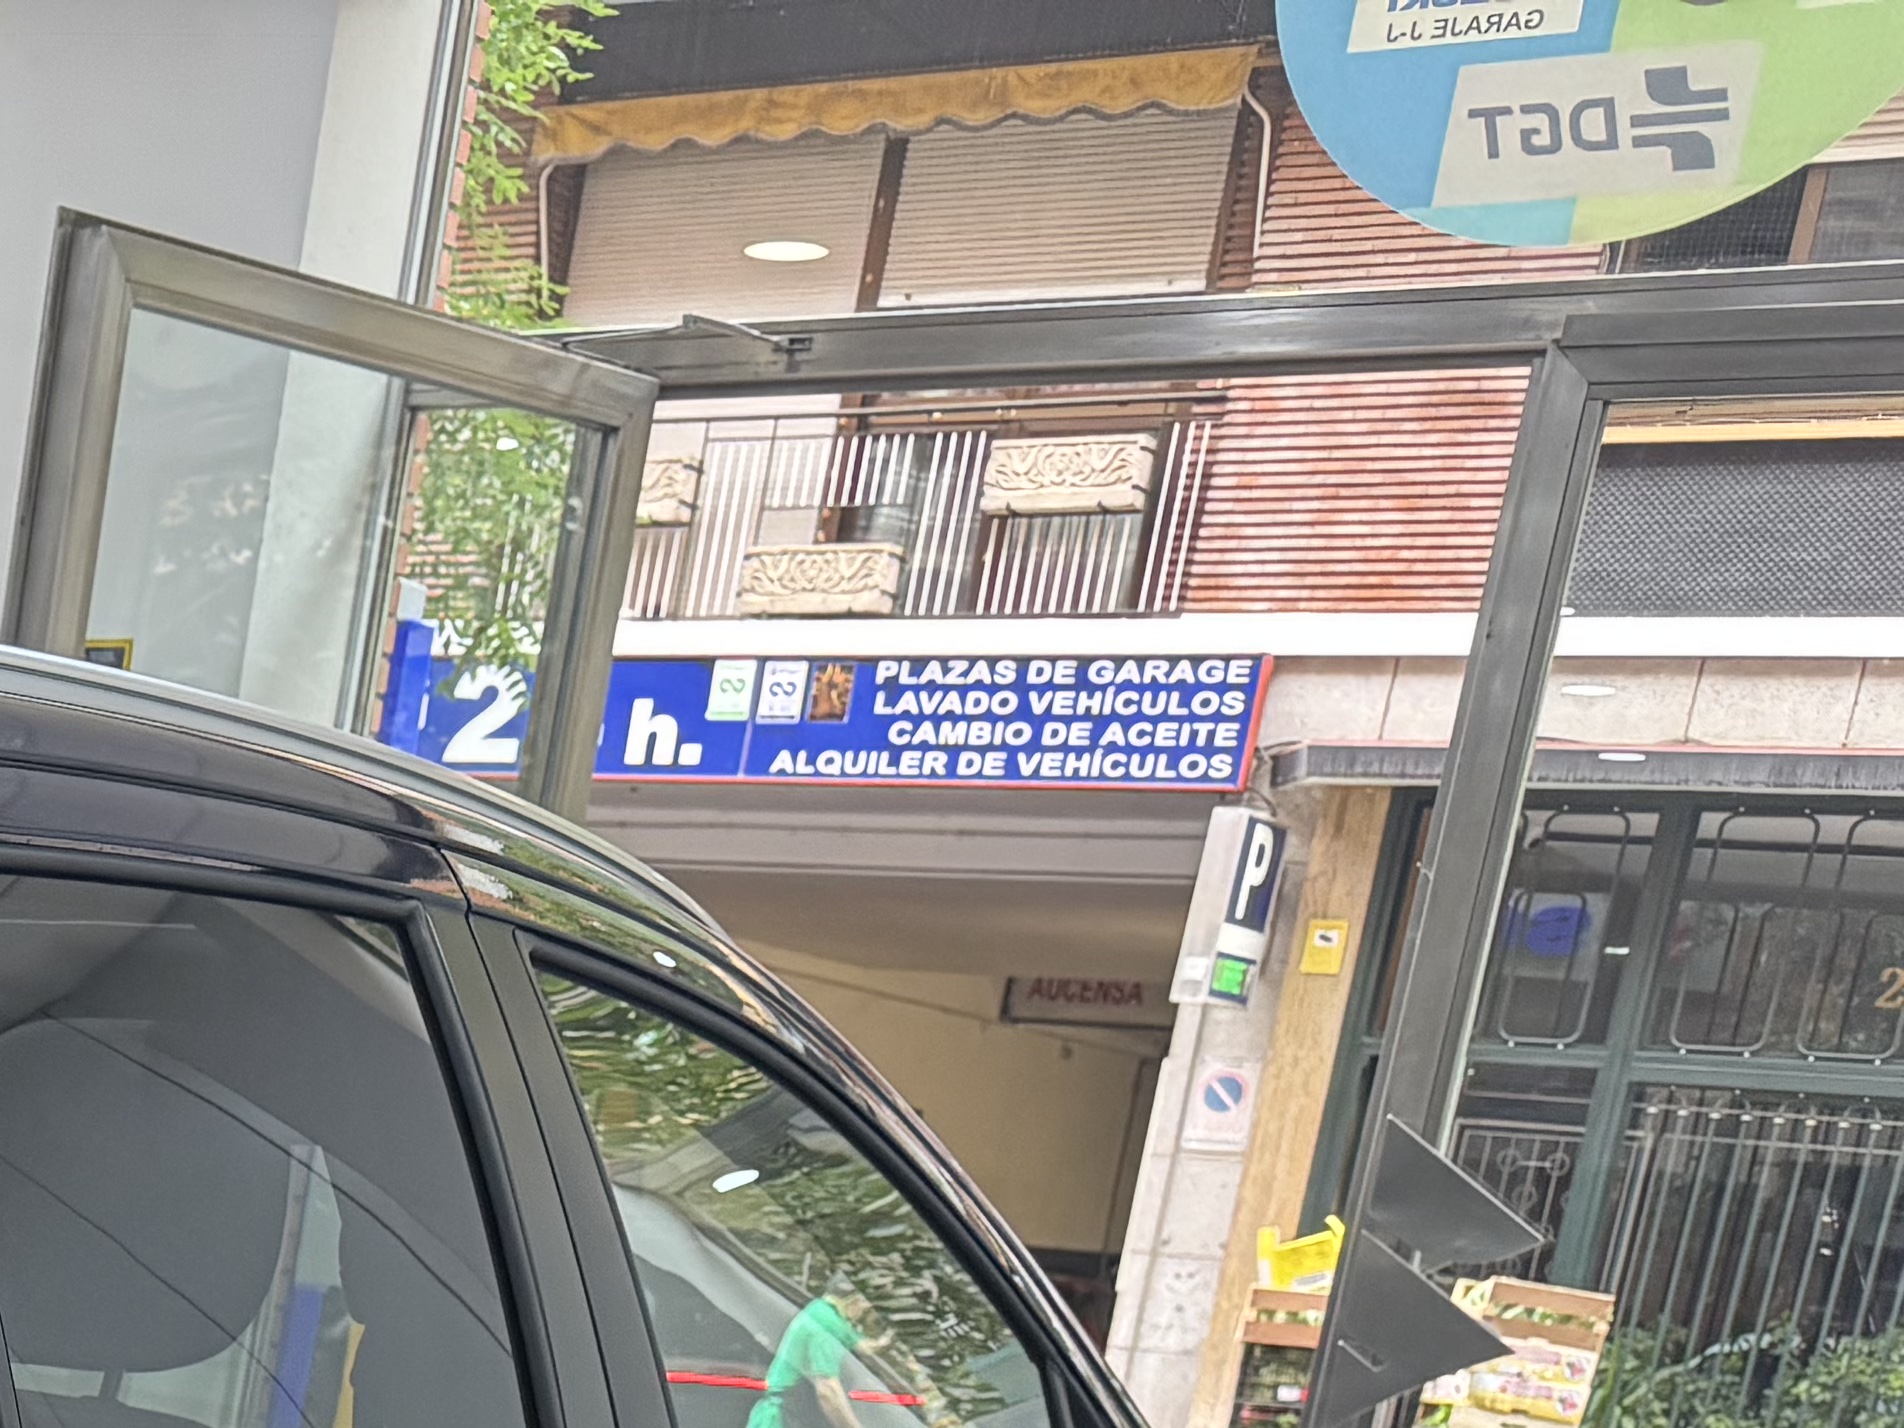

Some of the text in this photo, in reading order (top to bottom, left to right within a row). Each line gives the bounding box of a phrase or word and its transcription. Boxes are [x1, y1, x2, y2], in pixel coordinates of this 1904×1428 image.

[874, 659, 1254, 685] PLAZAS DE GARAGE
[873, 685, 1246, 717] LAVADO VEHÍCULOS
[887, 721, 1242, 748] CAMBIO DE ACEITE
[768, 746, 1234, 779] ALQUILER DE VEHÍCULOS
[1233, 821, 1275, 921] P
